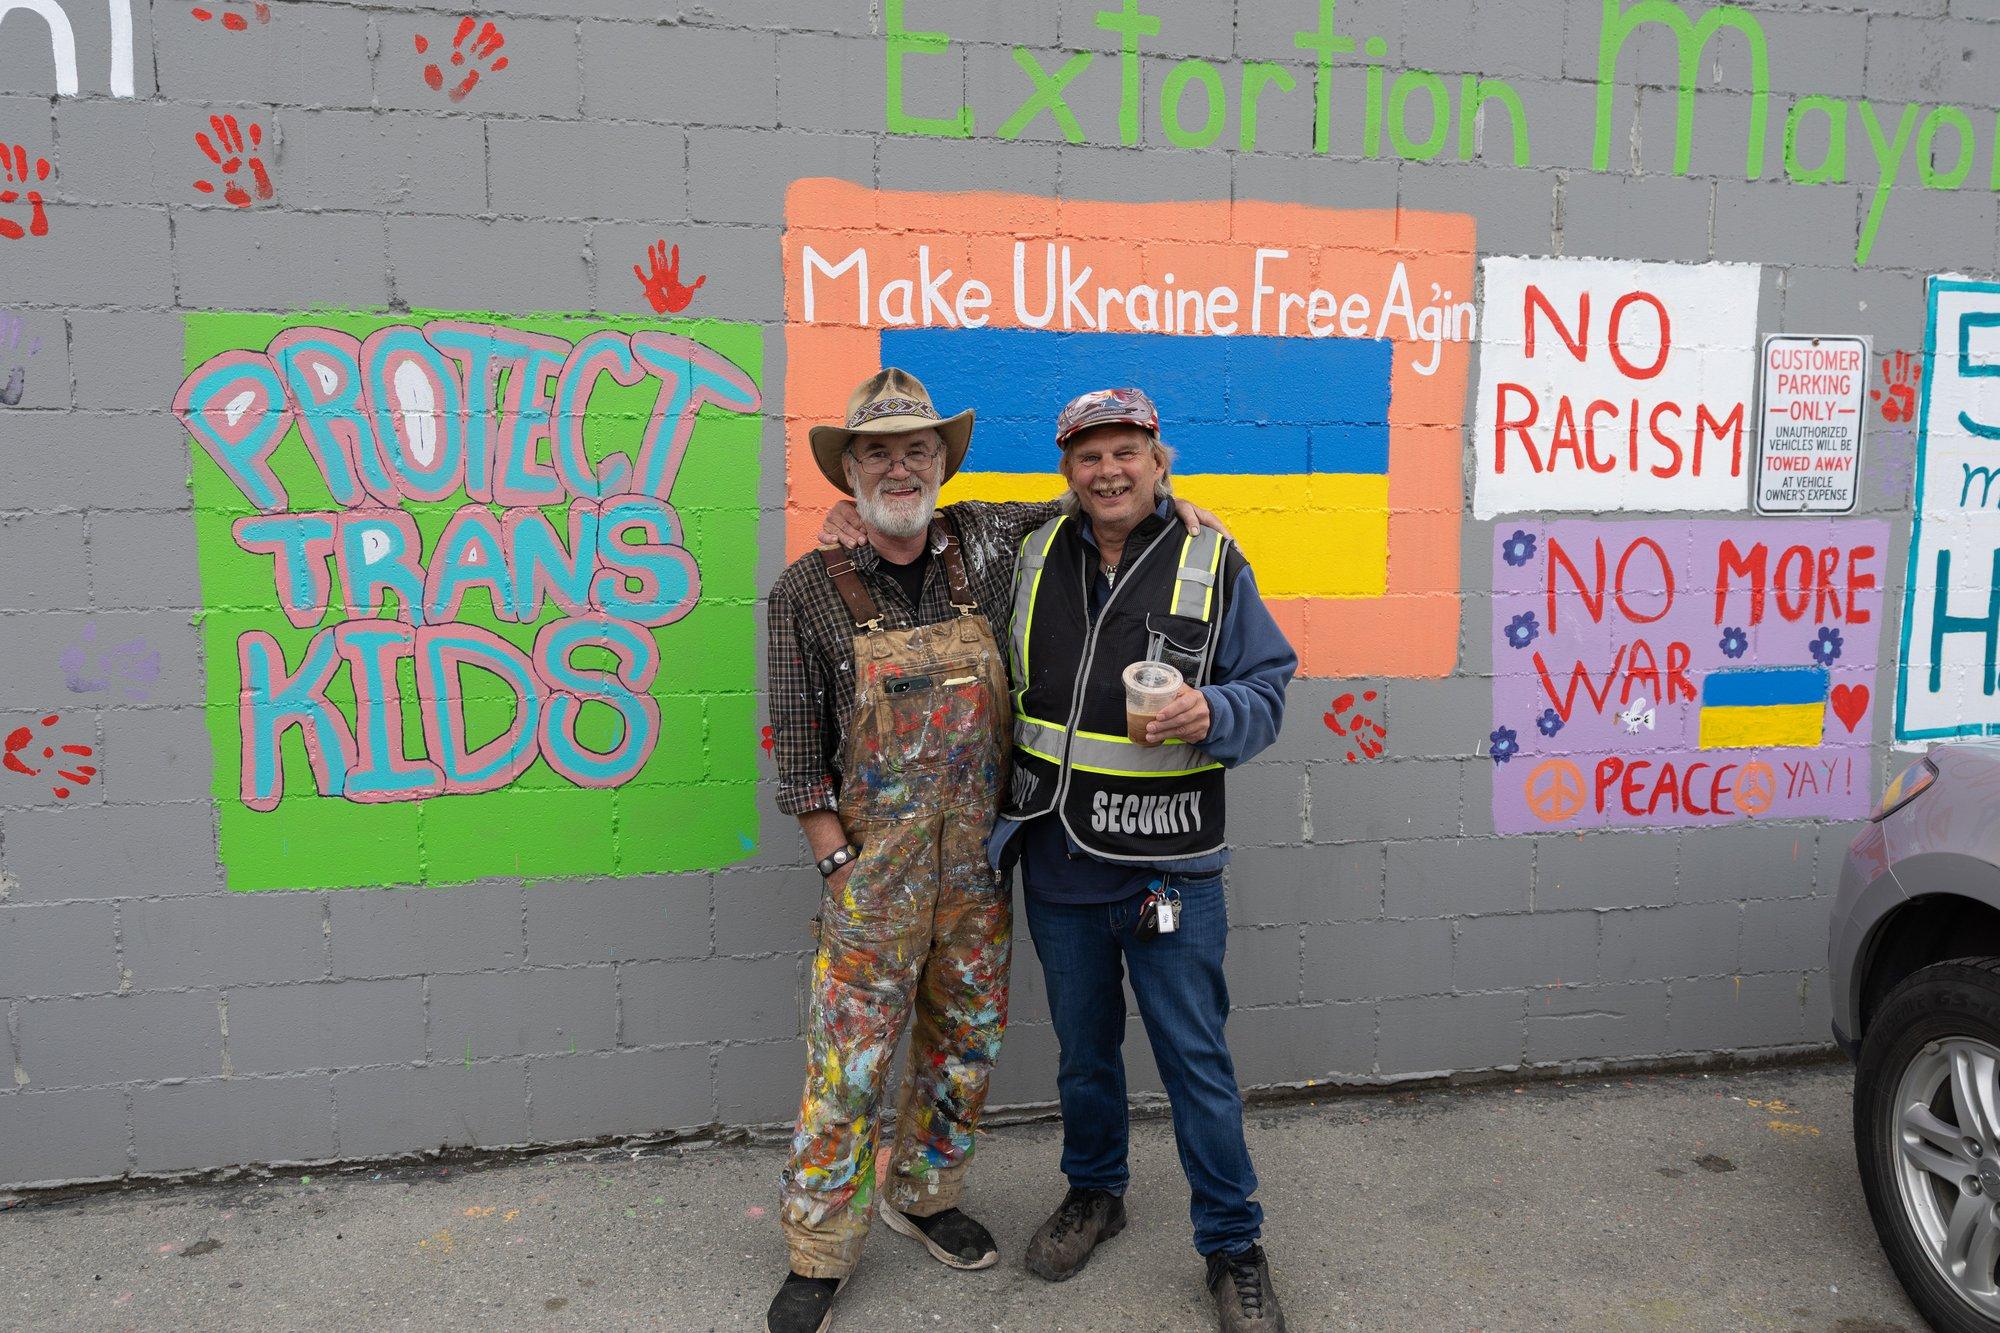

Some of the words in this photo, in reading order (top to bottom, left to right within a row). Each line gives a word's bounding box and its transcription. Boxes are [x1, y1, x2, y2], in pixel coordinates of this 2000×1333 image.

[885, 0, 1531, 168] Extortion
[1593, 0, 2000, 266] Mayo
[803, 245, 992, 328] Make
[1013, 242, 1239, 335] Ukraine
[1251, 248, 1371, 338] Free
[1524, 284, 1672, 380] NO
[1770, 350, 1860, 371] CUSTOMER
[1778, 374, 1851, 395] PARKING
[1790, 401, 1836, 420] ONLY
[171, 321, 762, 513] PROTECT
[1494, 383, 1744, 478] RACISM
[1769, 439, 1813, 451] VEHICLES
[1816, 440, 1837, 451] WILL
[1840, 440, 1852, 451] BE
[1776, 426, 1848, 438] UNAUTHORIZED
[1766, 456, 1810, 471] TOWED
[1815, 456, 1853, 471] AWAY
[1782, 476, 1794, 488] AT
[1797, 476, 1833, 488] VEHICLE
[1765, 489, 1805, 501] OWNER'S
[1807, 489, 1848, 501] EXPENSE
[231, 492, 700, 628] TRANS
[1547, 536, 1675, 636] NO
[1714, 538, 1877, 627] MORE
[1532, 638, 1698, 723] WAR
[236, 611, 661, 812] KIDS
[1091, 790, 1202, 835] SECURITY
[1594, 756, 1738, 816] PEACE
[1783, 757, 1852, 799] YAY!
